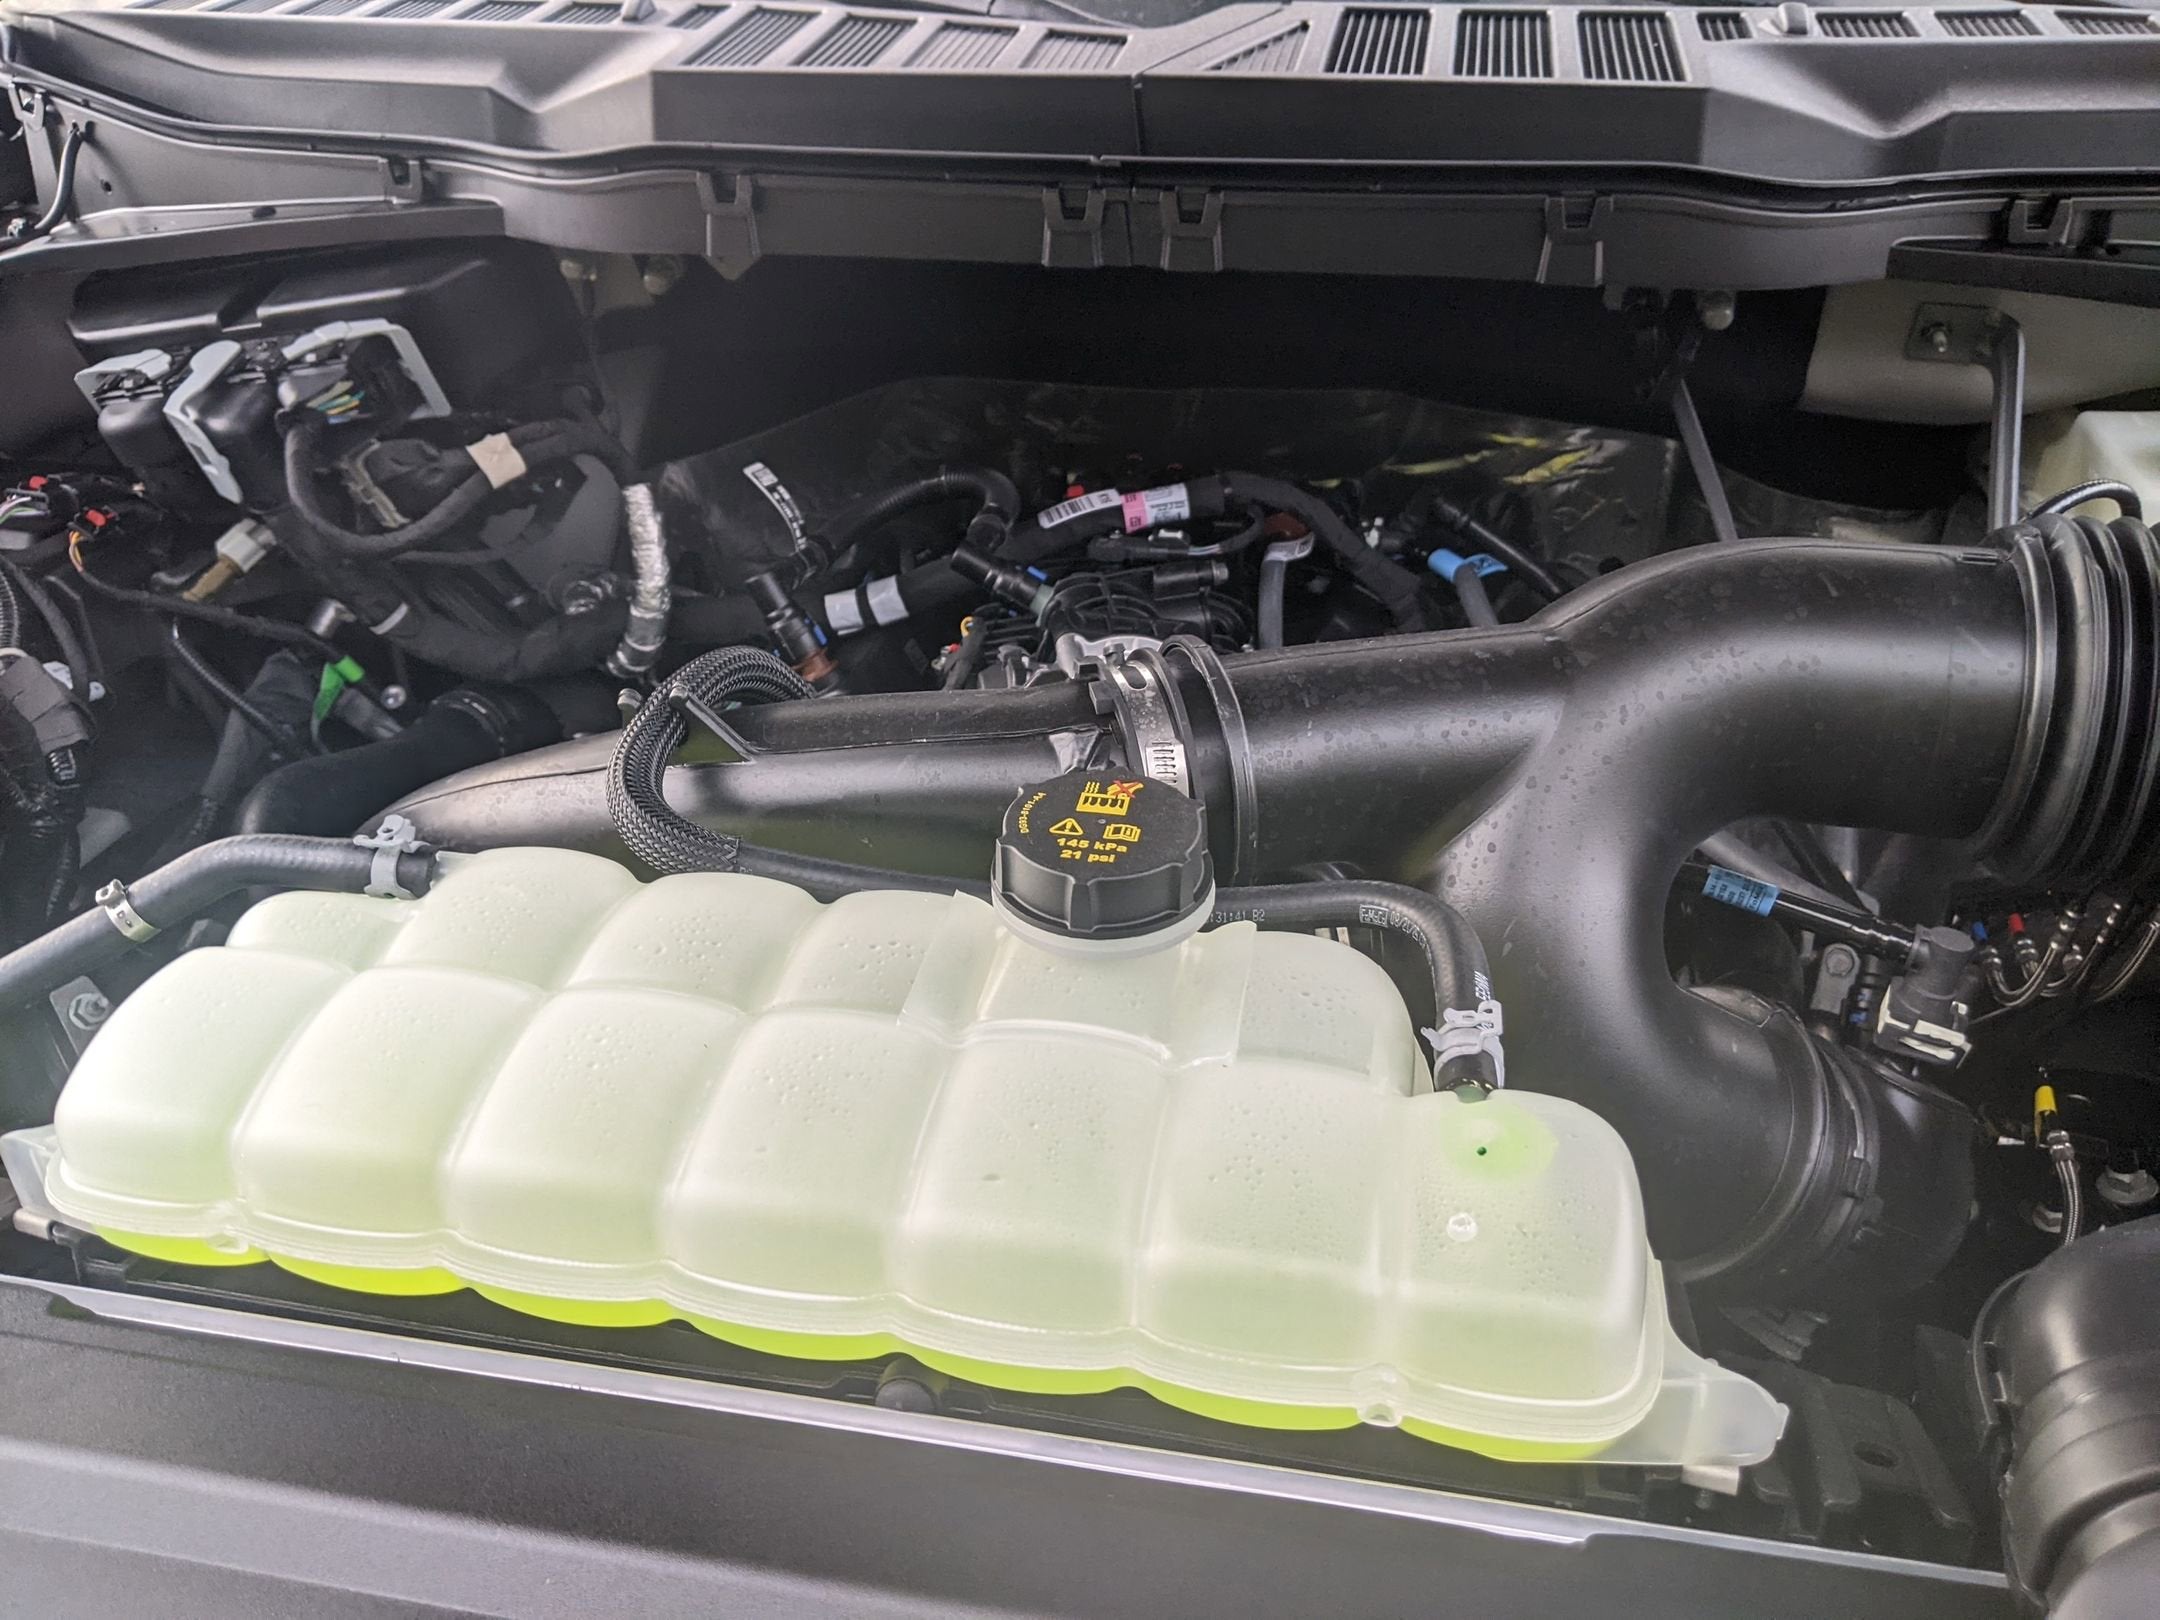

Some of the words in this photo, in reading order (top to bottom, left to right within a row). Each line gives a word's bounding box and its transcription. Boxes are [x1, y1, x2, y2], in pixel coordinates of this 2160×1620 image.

[1057, 837, 1090, 849] 145
[1093, 841, 1128, 853] kPa
[1060, 849, 1082, 860] 21
[1087, 853, 1116, 864] psi
